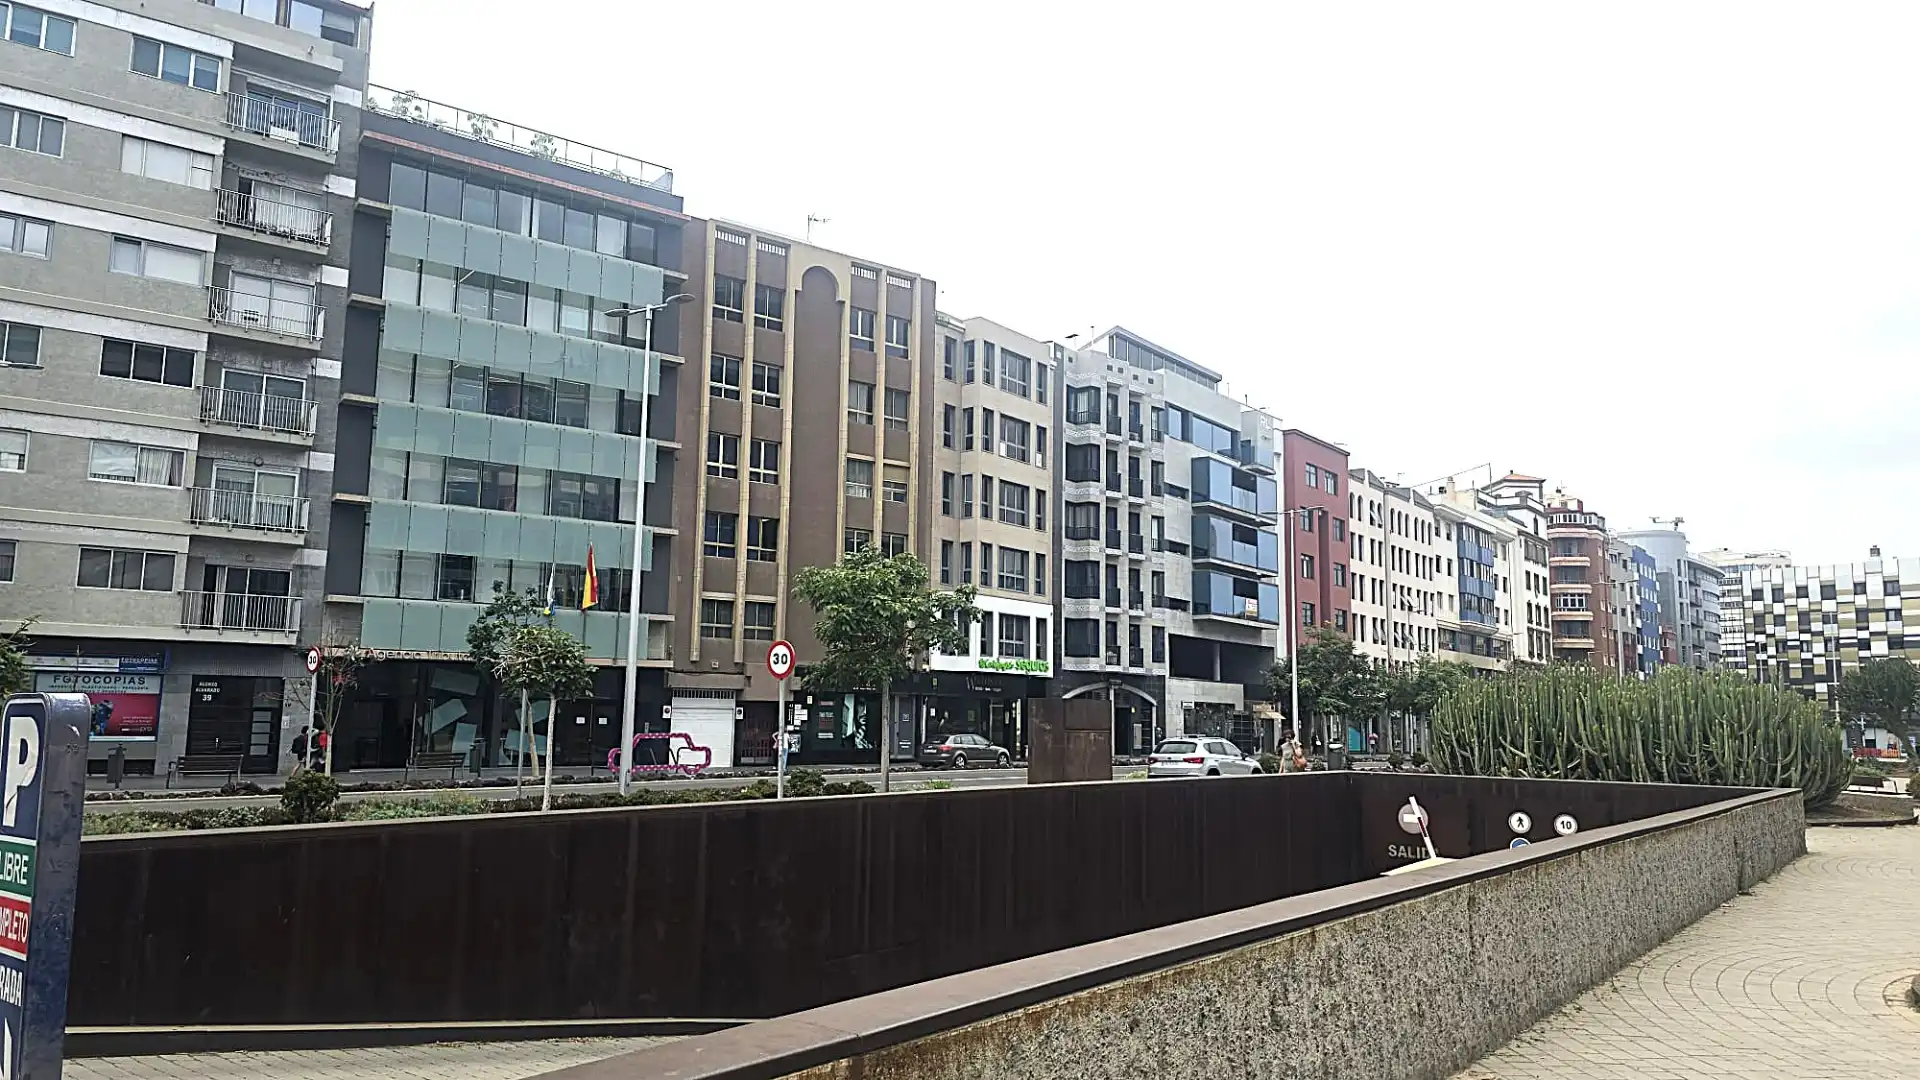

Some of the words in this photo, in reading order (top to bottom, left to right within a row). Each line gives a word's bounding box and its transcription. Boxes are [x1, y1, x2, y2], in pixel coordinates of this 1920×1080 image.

[309, 656, 316, 664] 30
[773, 653, 788, 665] 30
[53, 675, 146, 685] FOTOCOPIAS
[202, 694, 212, 702] 39
[3, 716, 39, 827] P
[1560, 820, 1572, 830] 10
[1388, 844, 1440, 859] SALID
[0, 850, 30, 885] LIBRE
[0, 906, 29, 944] MPLETO
[0, 965, 23, 1007] RADA
